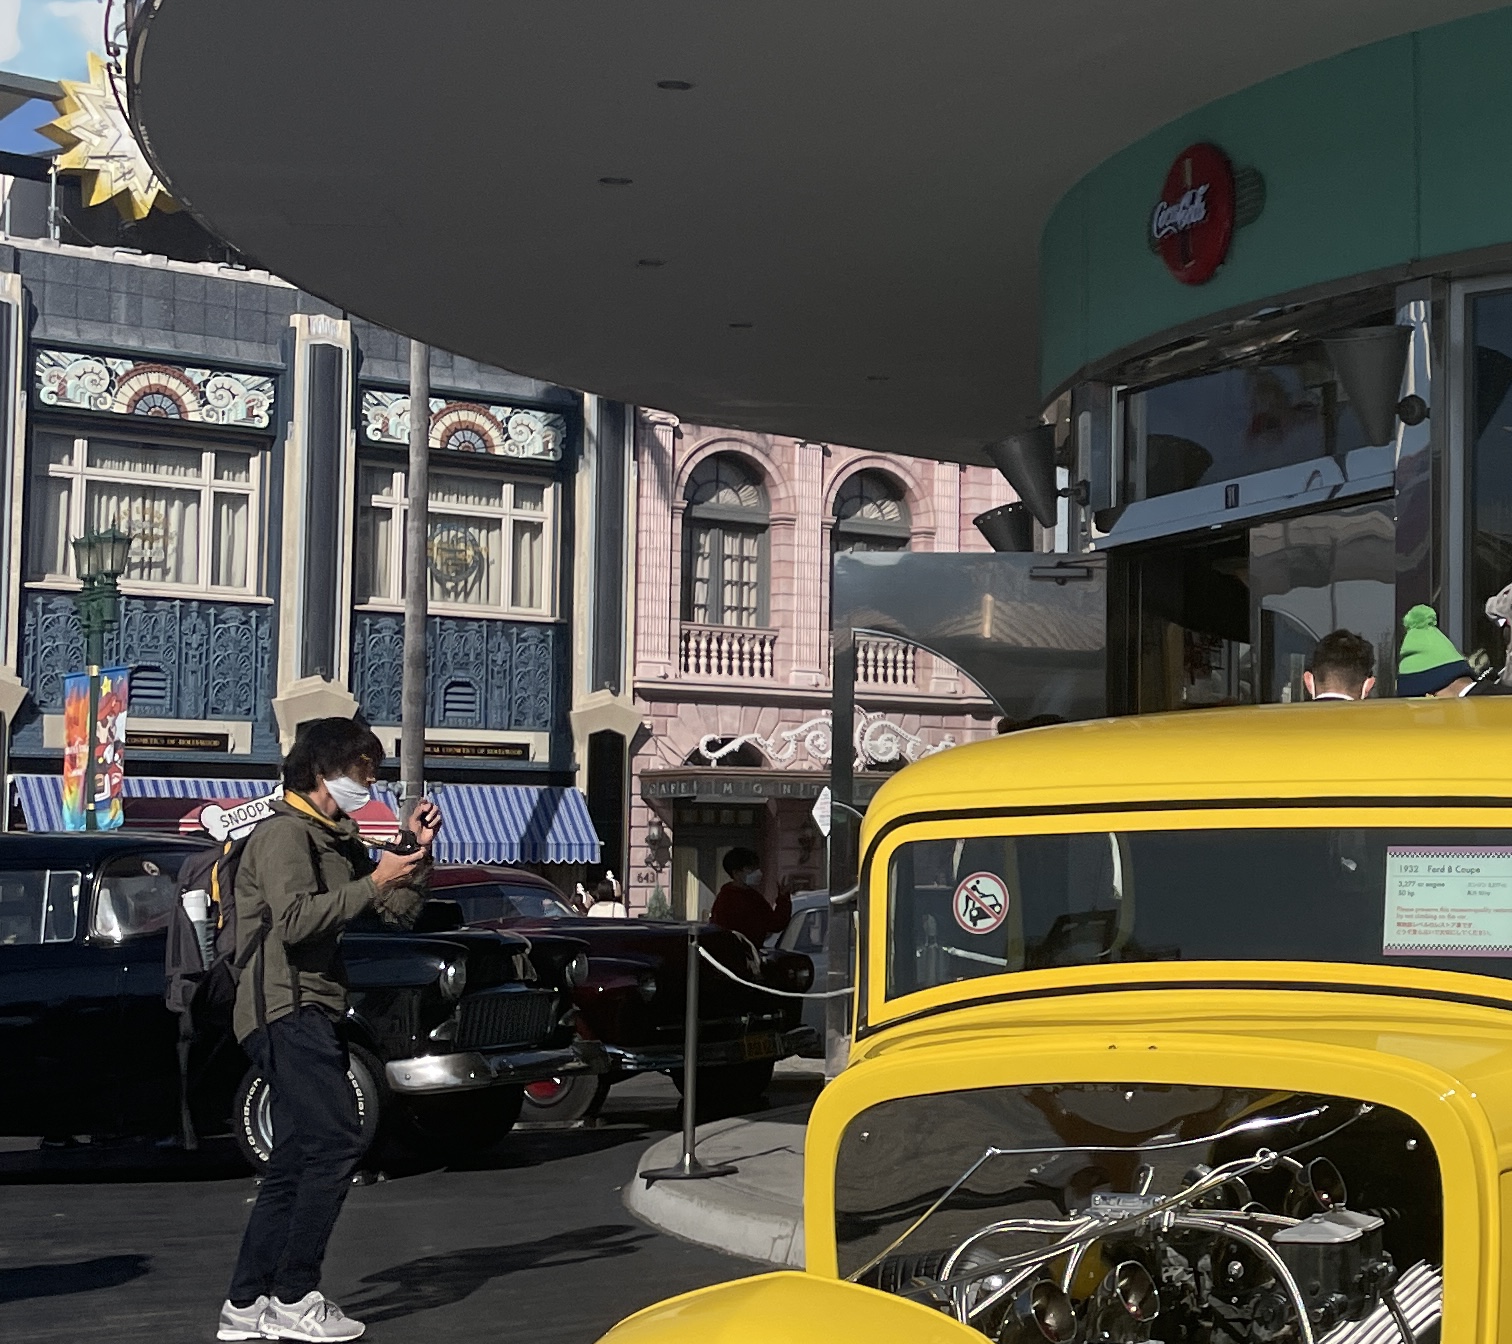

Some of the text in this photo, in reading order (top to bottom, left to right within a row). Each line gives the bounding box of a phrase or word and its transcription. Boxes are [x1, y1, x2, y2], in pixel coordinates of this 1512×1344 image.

[1399, 865, 1419, 873] 1932
[1427, 865, 1446, 873] Ford
[1455, 865, 1481, 875] Coupe
[637, 872, 655, 883] 643
